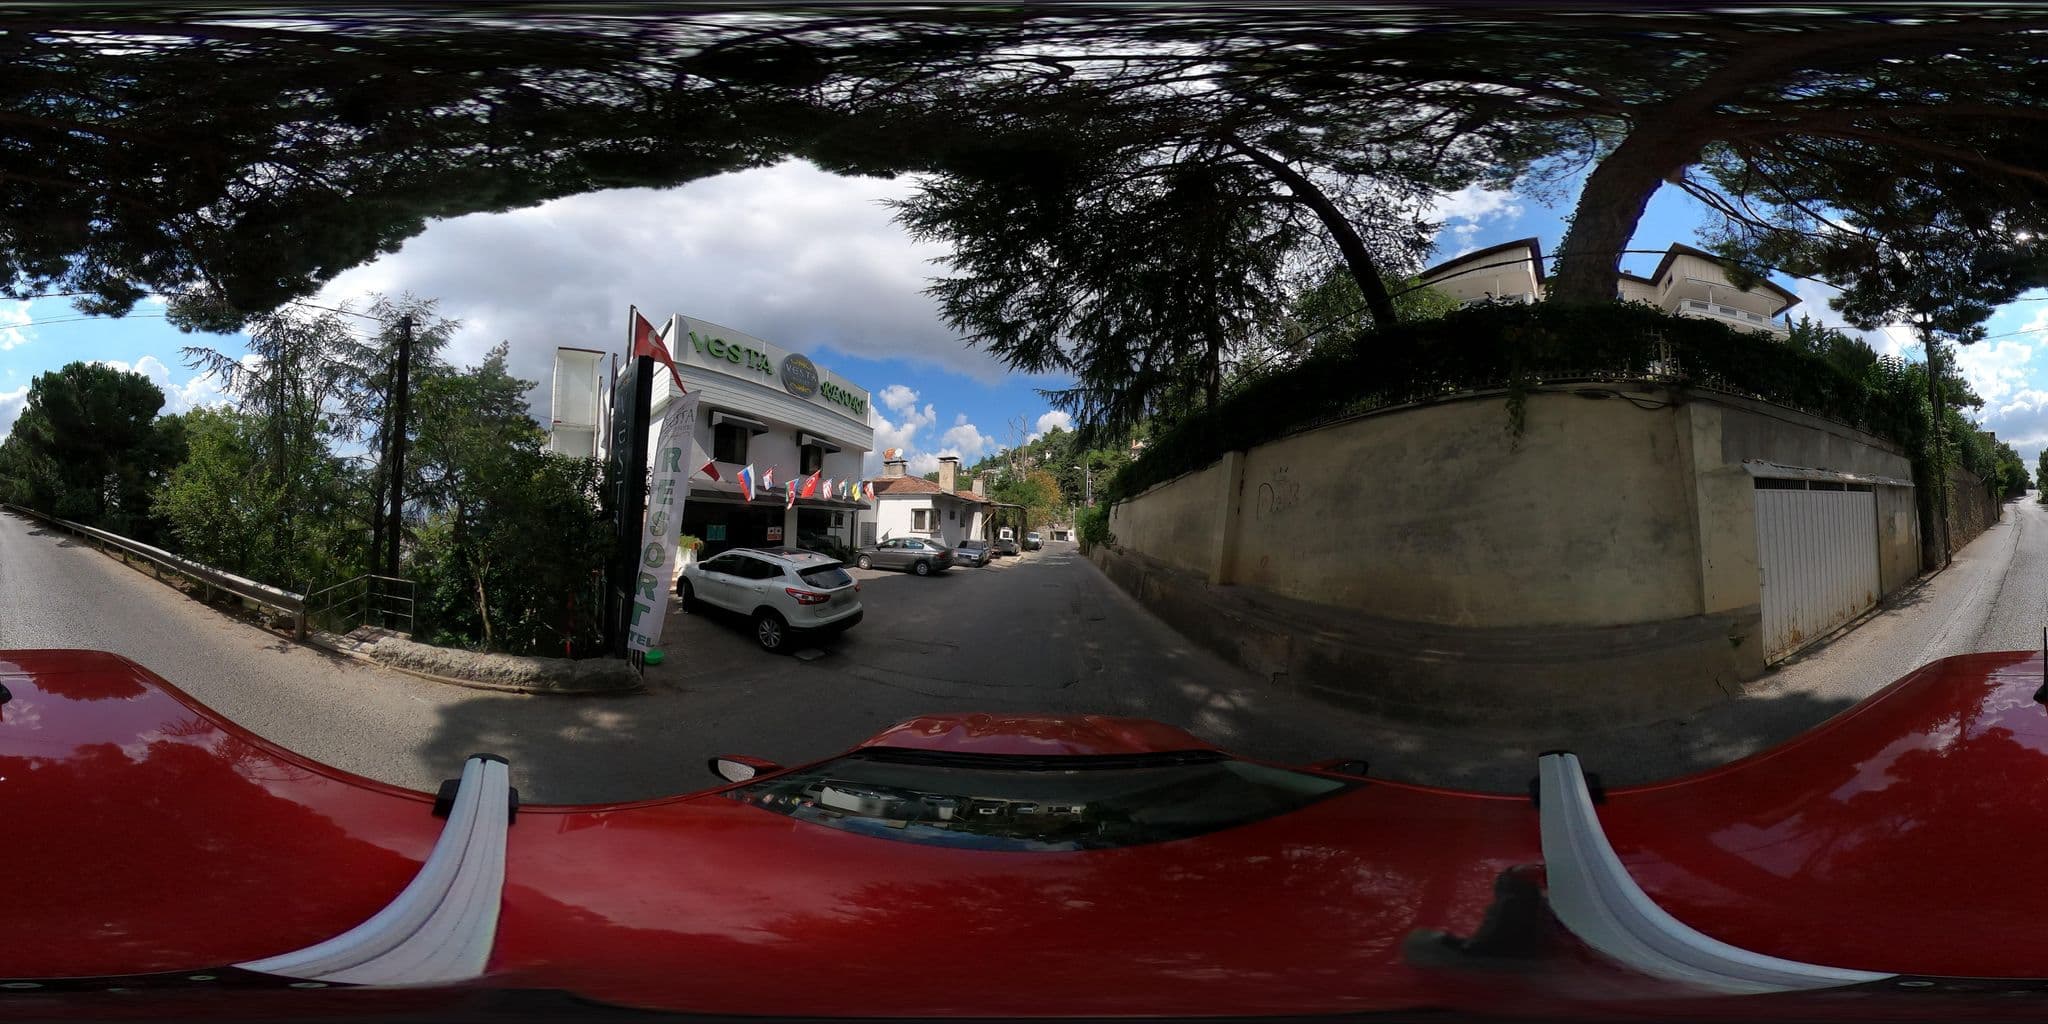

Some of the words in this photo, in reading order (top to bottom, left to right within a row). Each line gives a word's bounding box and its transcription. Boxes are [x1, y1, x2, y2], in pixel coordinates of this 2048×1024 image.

[820, 381, 866, 415] RESORT
[632, 447, 681, 626] RESORT
[628, 626, 655, 648] TEL
